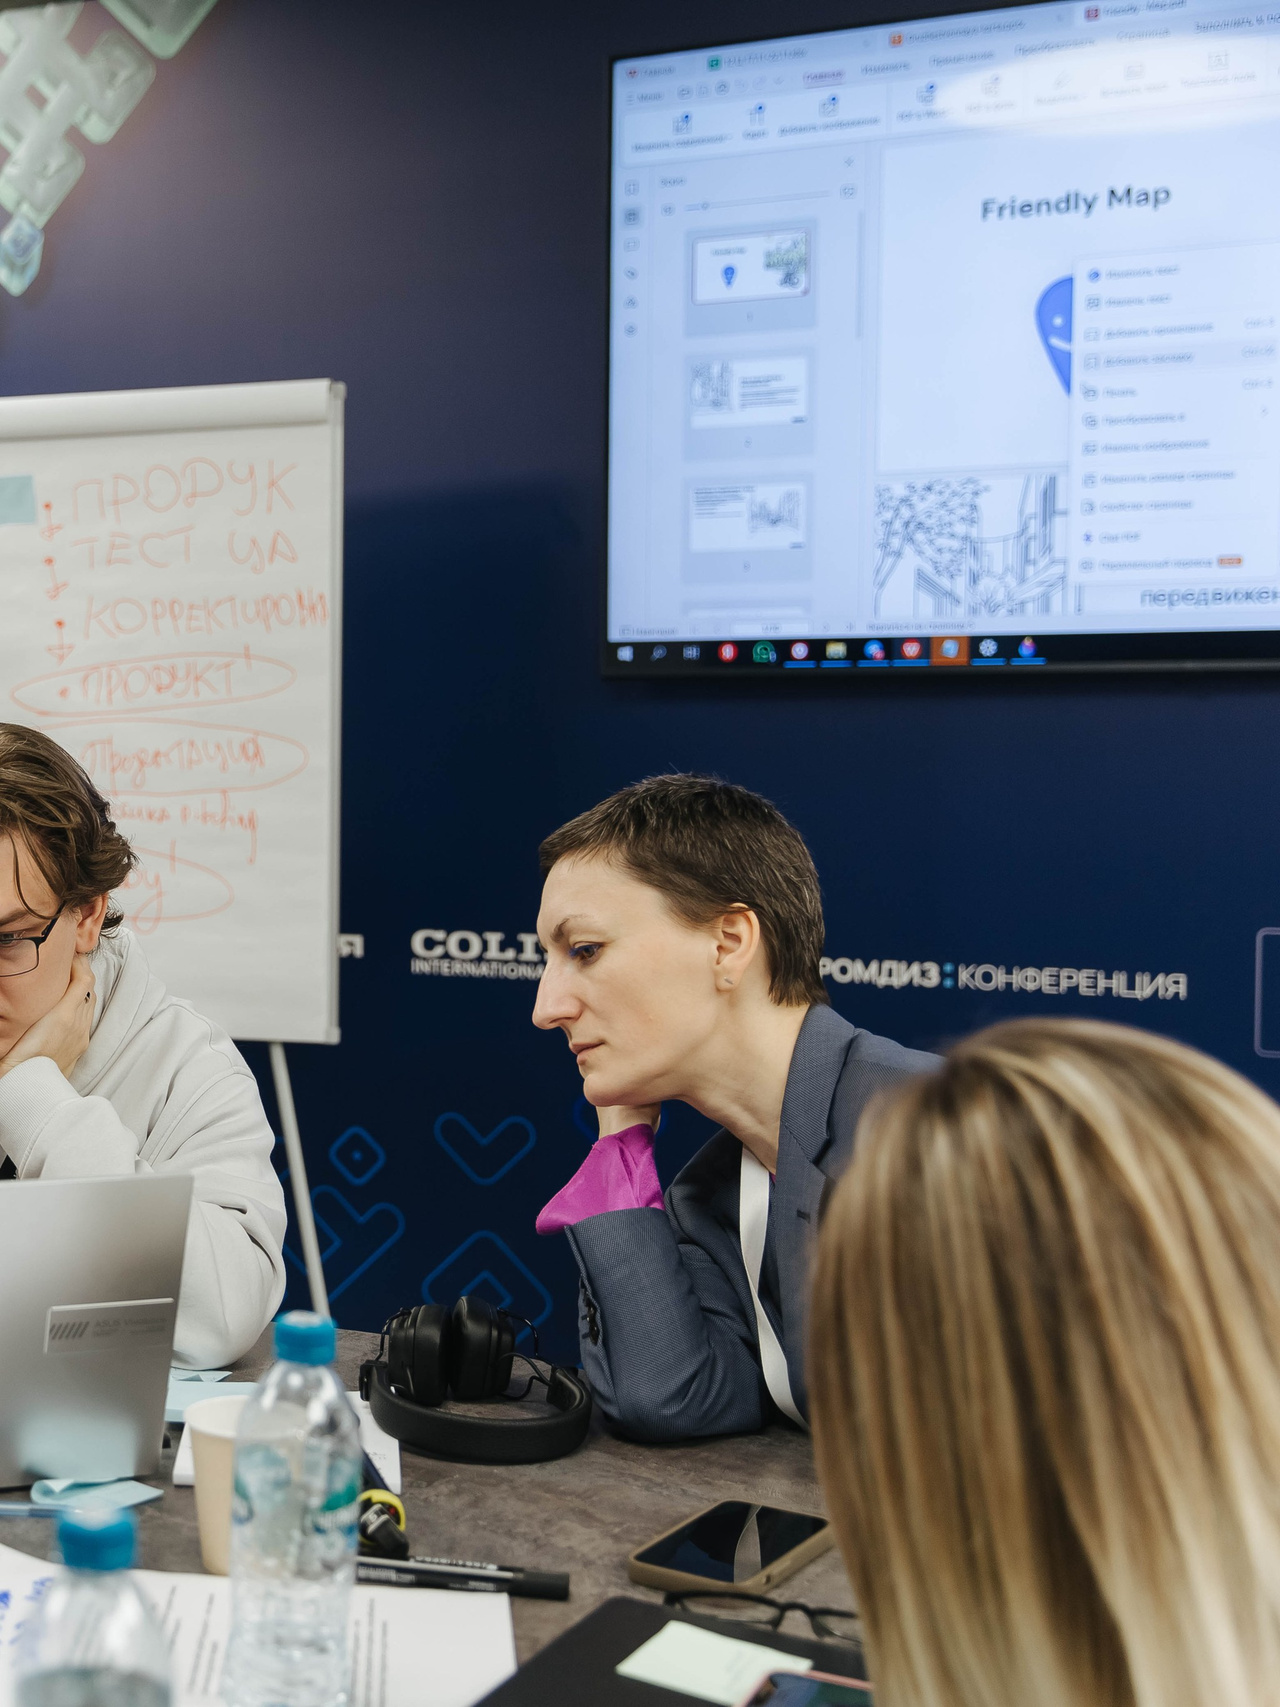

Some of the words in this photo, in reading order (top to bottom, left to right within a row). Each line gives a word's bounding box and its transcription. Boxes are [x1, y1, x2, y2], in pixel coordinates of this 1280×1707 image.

[981, 189, 1098, 222] Friendly
[1107, 185, 1172, 212] Map
[71, 524, 196, 570] ТЕСТ
[81, 659, 238, 707] ПРОДУКТ
[410, 928, 548, 962] COLI
[410, 957, 545, 980] INTERNATIONA
[819, 955, 1188, 1001] РОМДИЗ:КОНФЕРЕНЦИЯ
